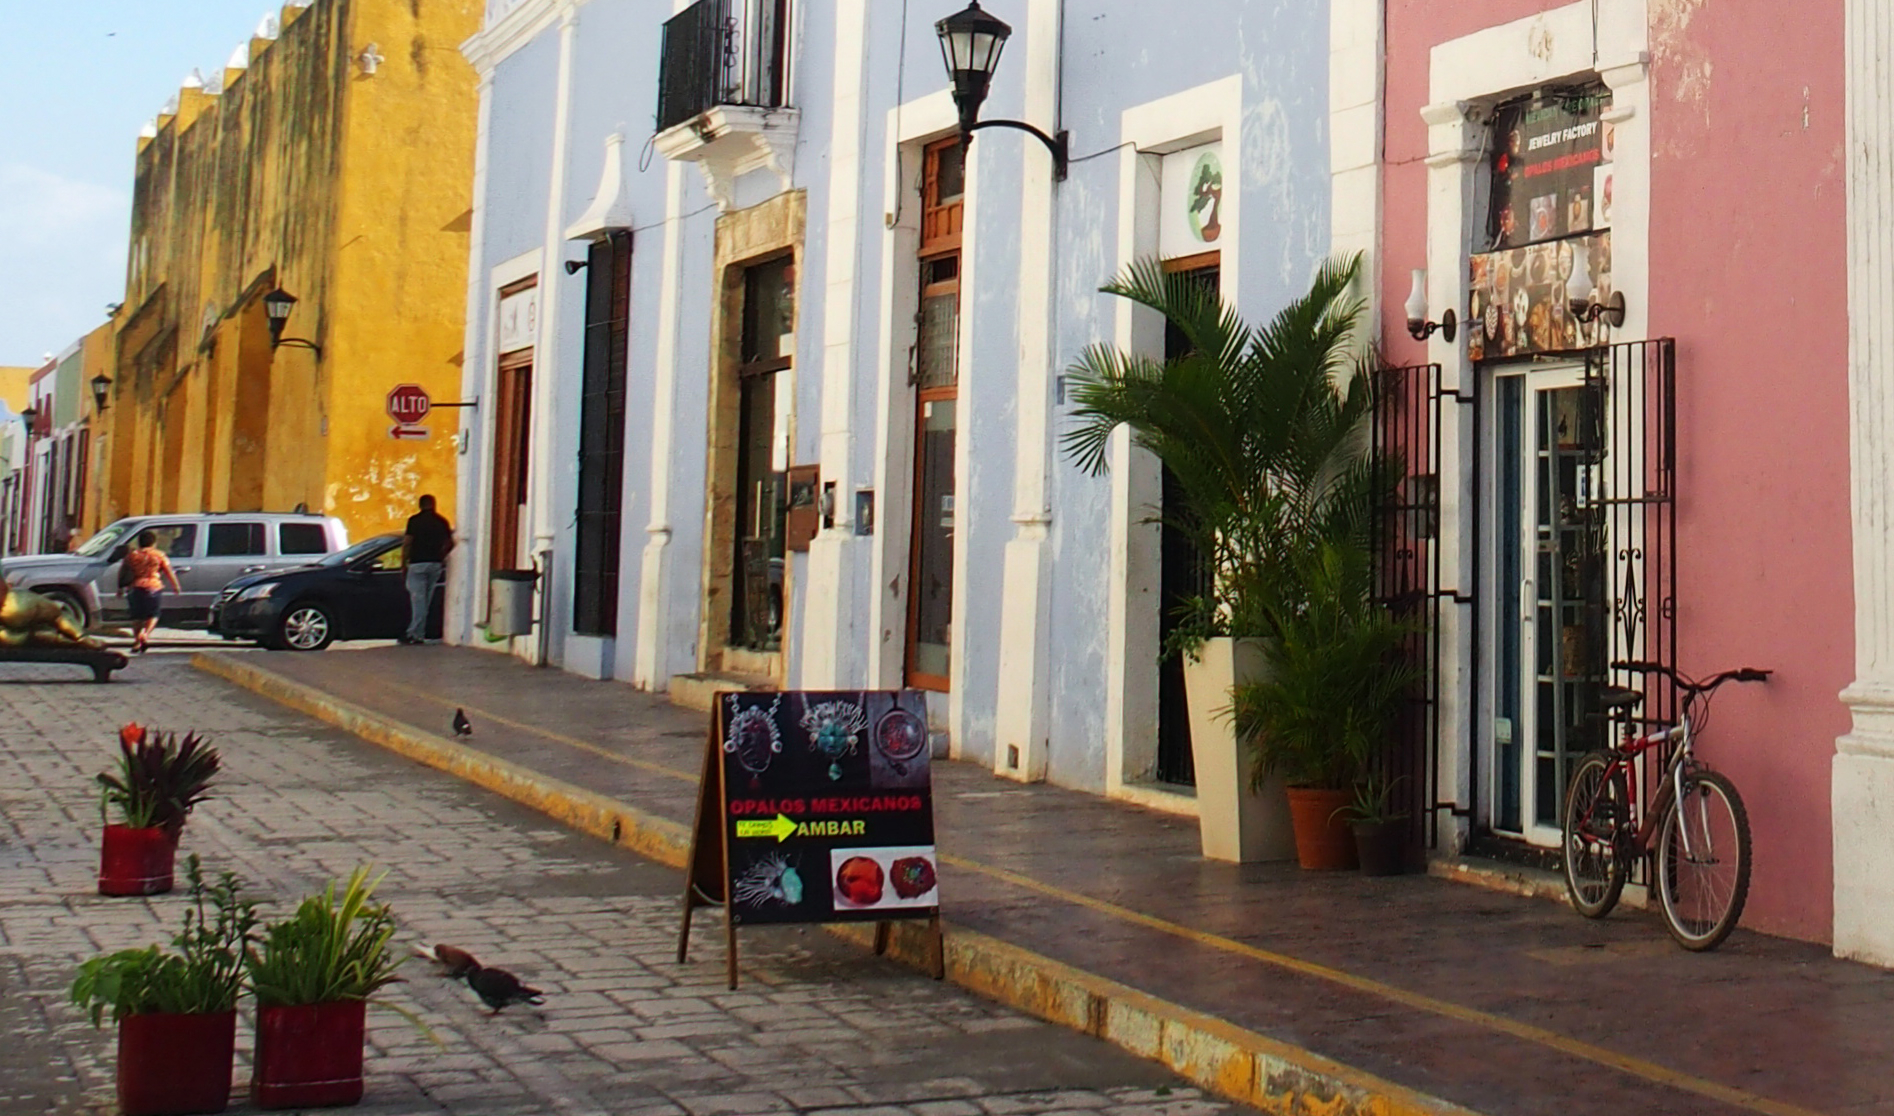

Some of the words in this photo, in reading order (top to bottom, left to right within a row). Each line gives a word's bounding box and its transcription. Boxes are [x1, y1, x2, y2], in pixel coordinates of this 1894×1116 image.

[1528, 130, 1562, 151] JEWELRY
[1562, 121, 1598, 142] FACTORY
[391, 395, 427, 413] ALTO
[730, 798, 805, 815] OPALOS
[811, 795, 922, 813] MEXICANOS
[797, 820, 865, 836] AMBAR
